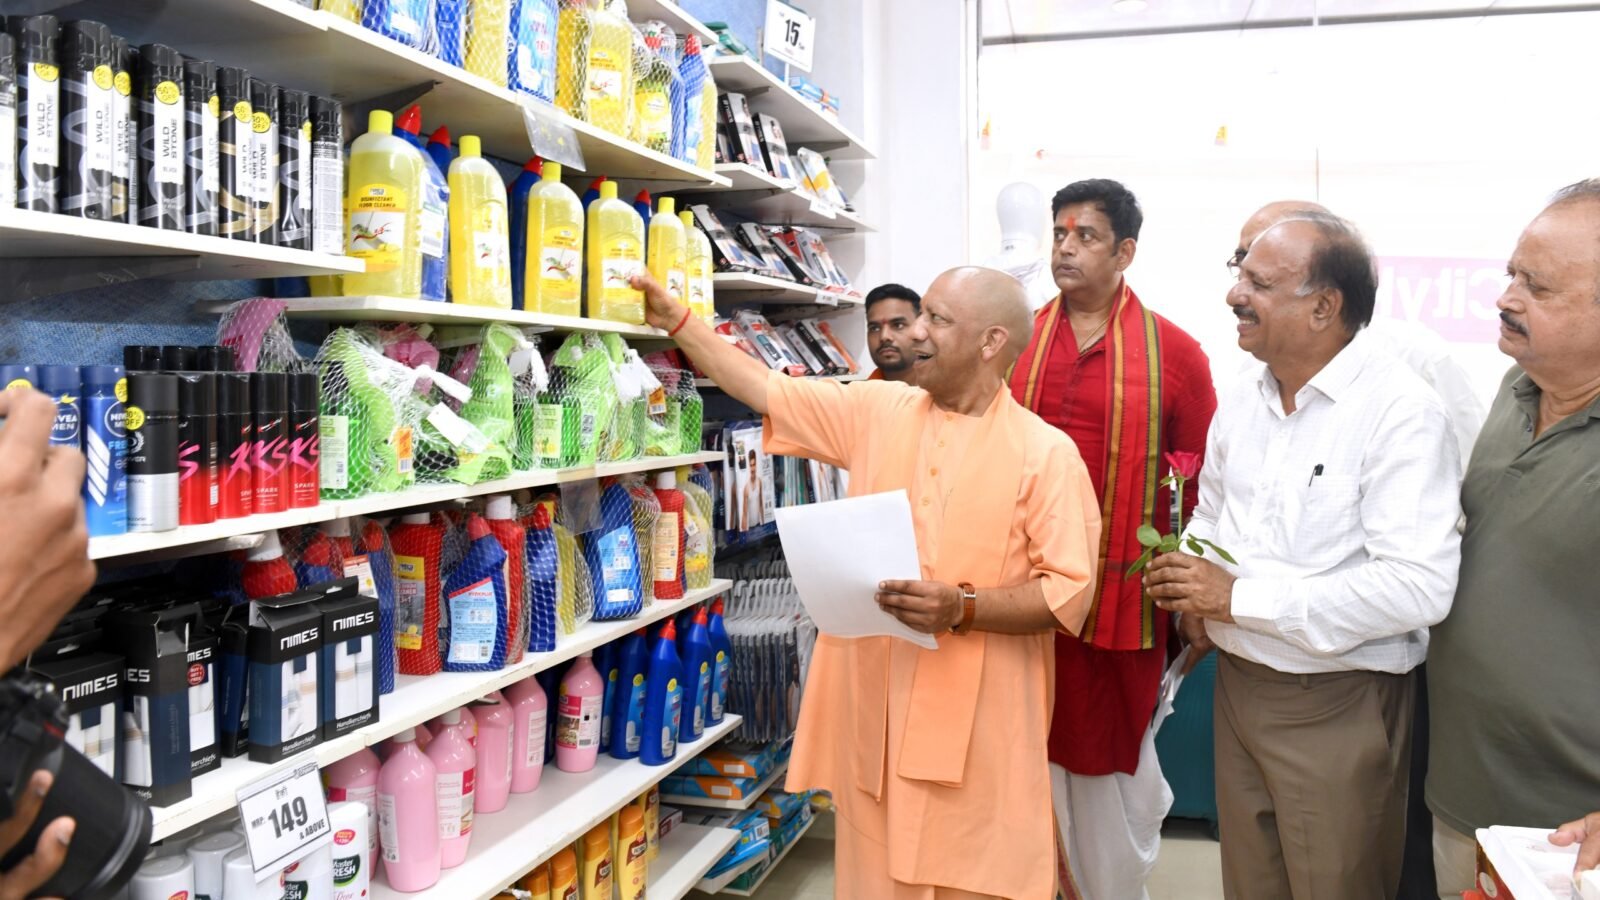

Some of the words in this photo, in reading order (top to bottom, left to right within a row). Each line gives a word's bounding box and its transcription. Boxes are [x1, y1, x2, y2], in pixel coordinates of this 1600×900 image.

[785, 19, 801, 47] 15
[37, 102, 46, 137] WILD
[46, 94, 55, 139] STONE
[96, 110, 104, 143] WILD
[162, 126, 171, 158] WILD
[171, 118, 180, 159] STONE
[260, 143, 268, 180] STONE
[126, 417, 141, 427] OFF
[108, 440, 128, 450] FRE
[293, 482, 315, 490] SPARK
[333, 611, 375, 632] NIMES
[281, 627, 319, 651] NIMES
[187, 647, 211, 663] MES
[63, 673, 118, 702] NIMES
[190, 755, 217, 769] kerchiefs
[268, 796, 309, 840] 149
[304, 818, 325, 838] ABOVE
[333, 865, 356, 878] RESH
[285, 890, 302, 900] ESH
